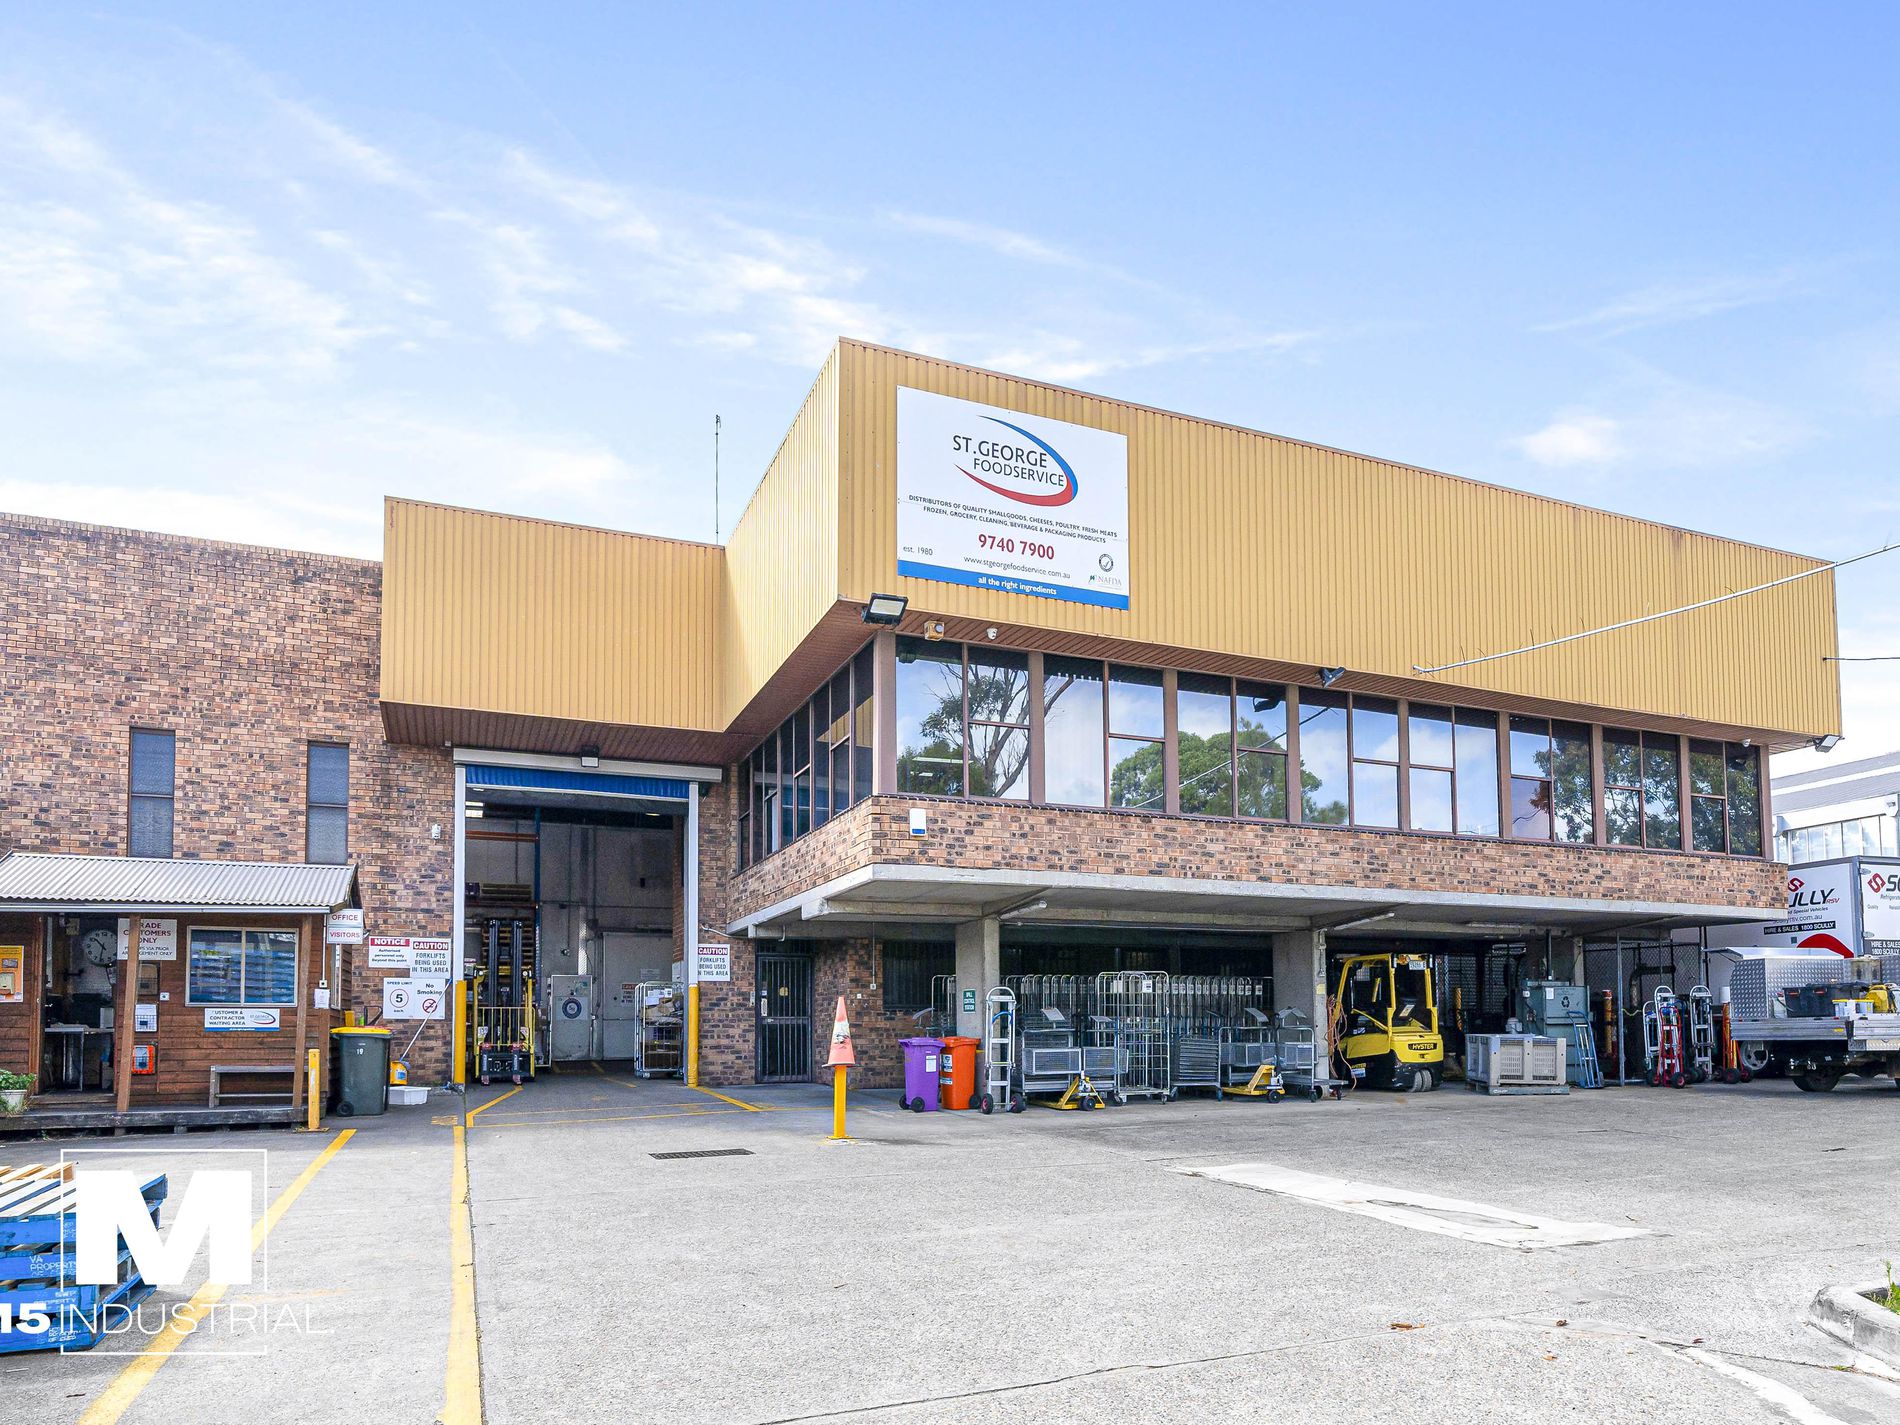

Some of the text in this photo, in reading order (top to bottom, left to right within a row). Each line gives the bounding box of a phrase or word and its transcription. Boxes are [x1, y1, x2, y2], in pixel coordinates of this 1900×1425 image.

[953, 435, 1048, 468] ST.GEORGE
[973, 458, 1064, 487] FOODSERVICE
[908, 494, 952, 508] DISTRIBUTORS
[962, 504, 988, 514] QUALITY
[1082, 526, 1098, 534] FRESH
[924, 506, 948, 516] FROZEN,
[950, 511, 978, 521] GROCERY,
[1010, 522, 1038, 532] BEVERAGE
[1044, 528, 1076, 538] PACKAGING
[1078, 534, 1106, 543] PRODUCTS
[917, 546, 934, 556] 1980
[978, 534, 1054, 560] 9740 7900
[978, 576, 1057, 595] all the right ingredients
[1886, 874, 1900, 892] S
[413, 942, 448, 950] CAUTION
[396, 994, 403, 1003] 5
